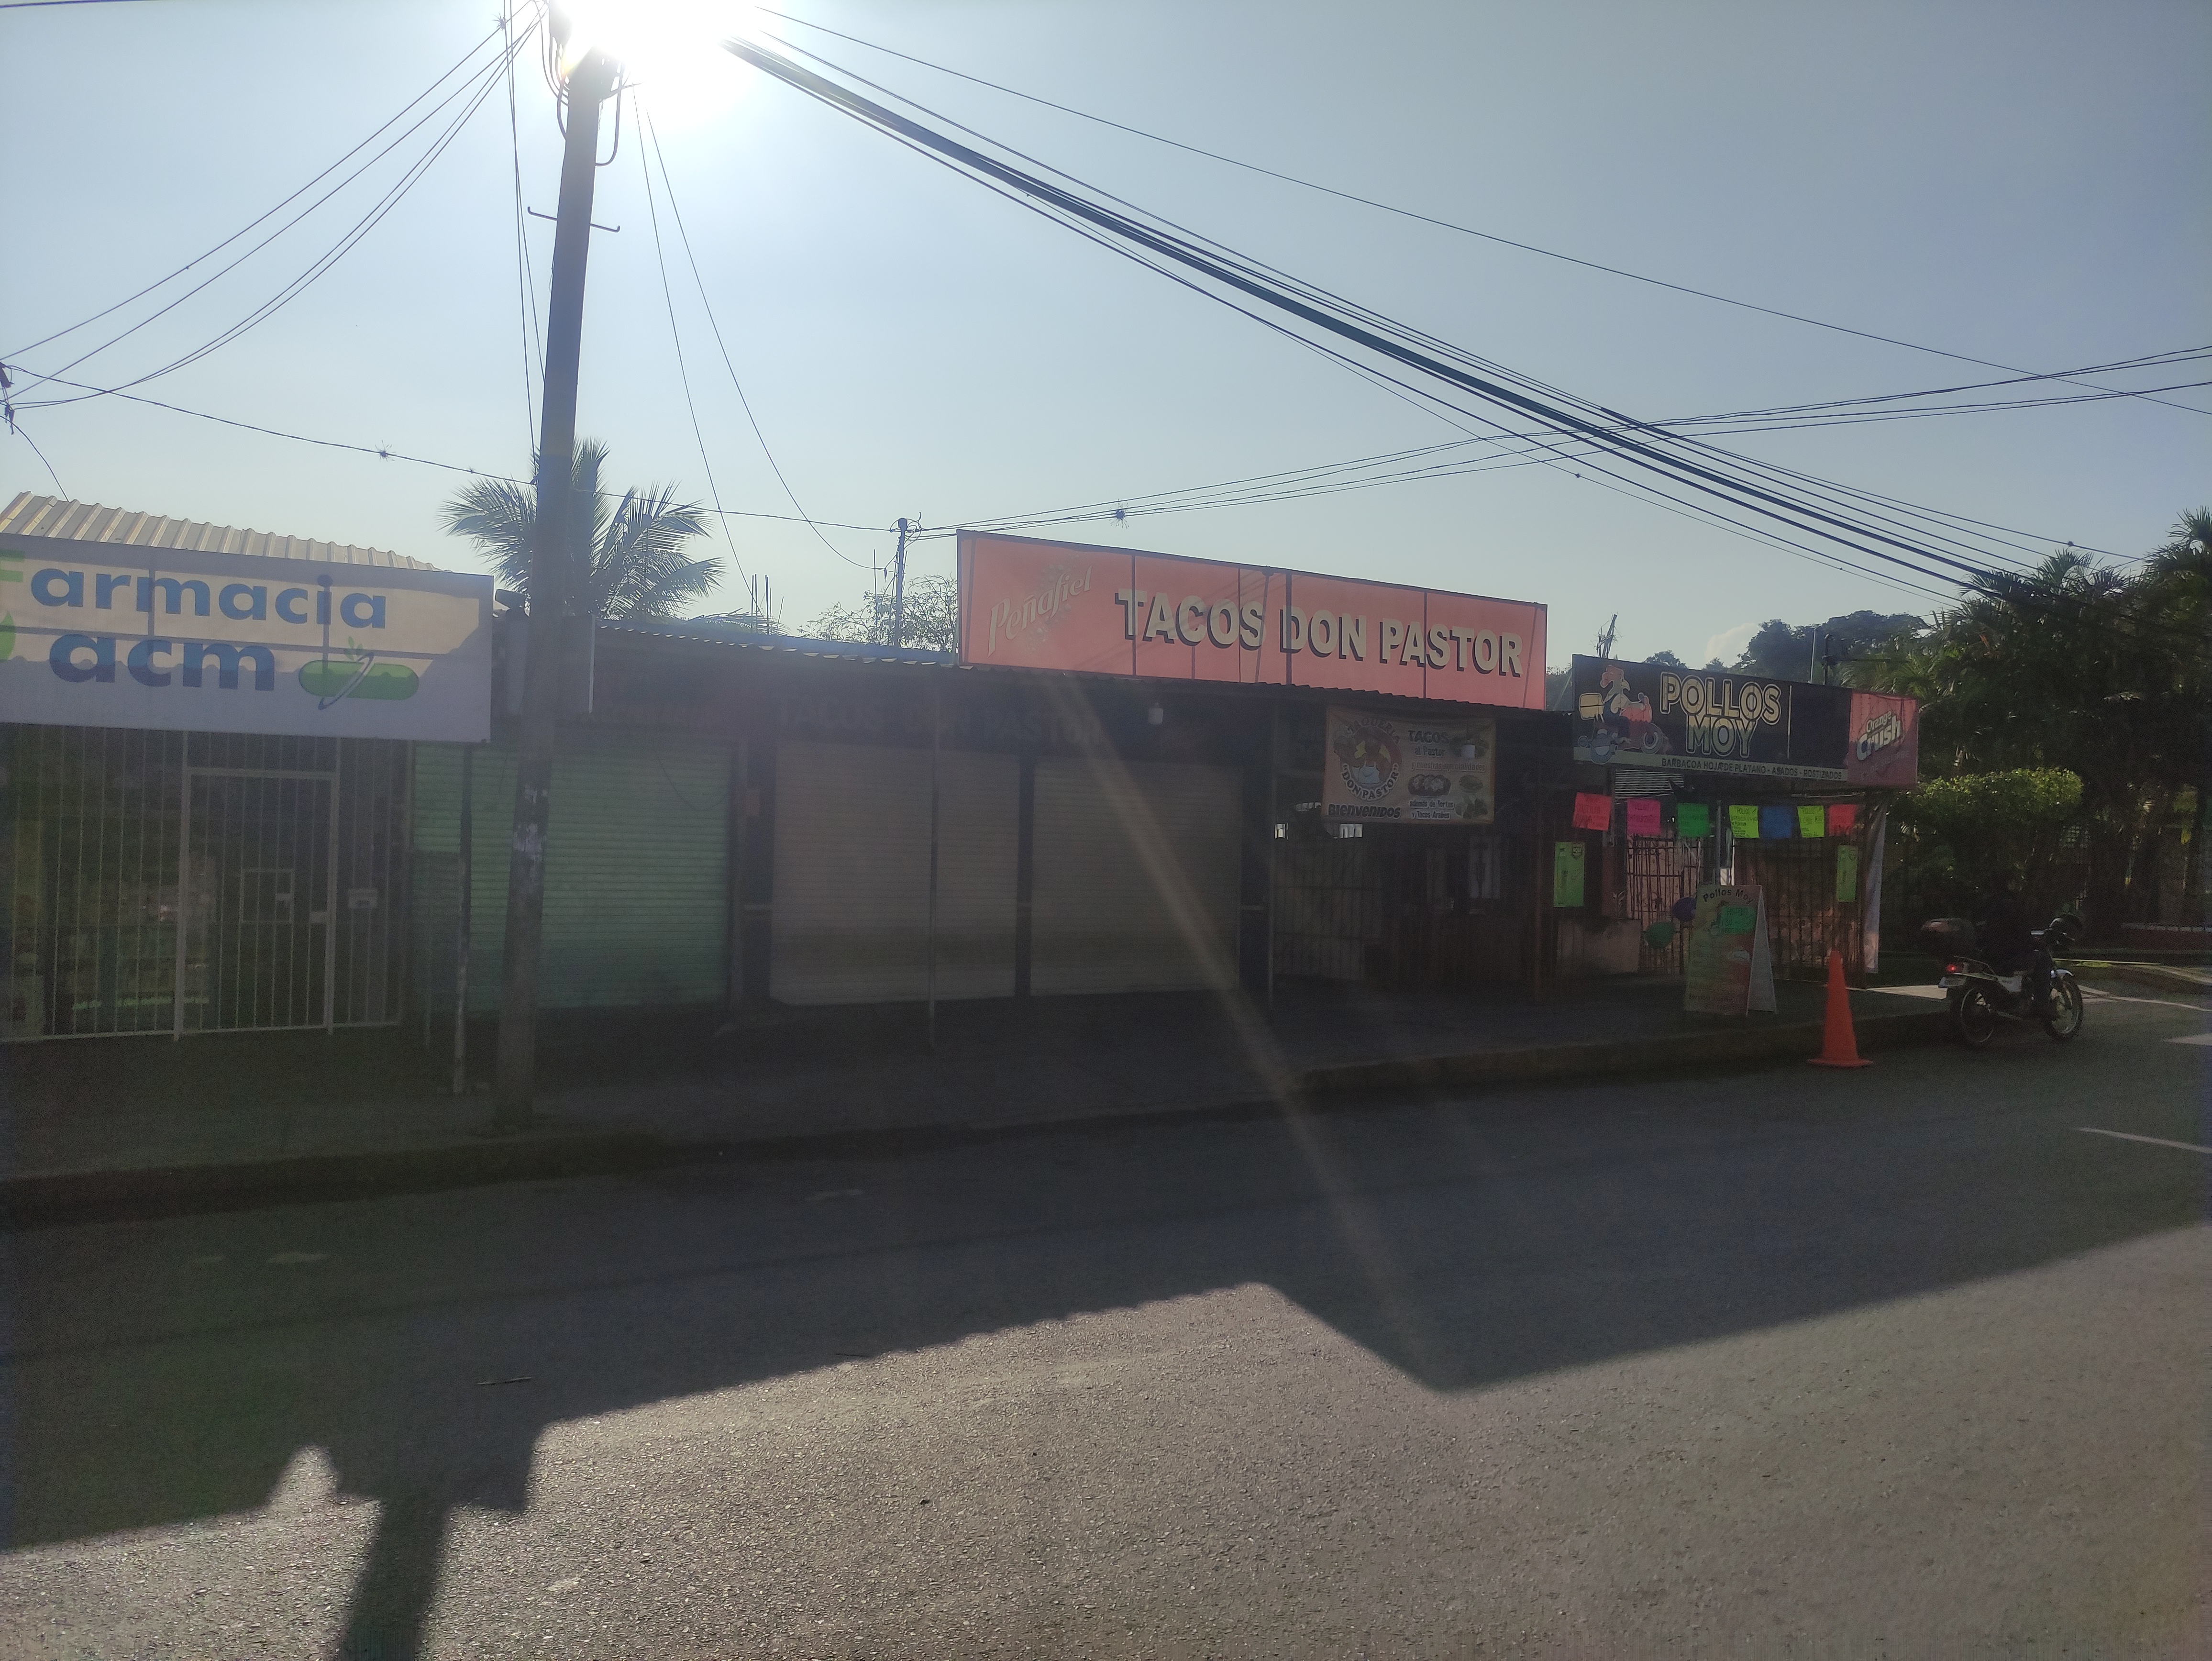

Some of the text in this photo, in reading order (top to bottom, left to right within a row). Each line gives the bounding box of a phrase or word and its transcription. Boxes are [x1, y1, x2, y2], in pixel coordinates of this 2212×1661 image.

[987, 564, 1093, 658] Peñafiel
[1115, 588, 1524, 677] TACOS DON PASTOR
[50, 634, 275, 691] acm
[1660, 672, 1781, 725] POLLOS
[1866, 711, 1891, 732] Orange
[1408, 730, 1449, 744] TACOS
[1686, 715, 1758, 758] MOY
[1857, 715, 1901, 760] Crush
[1415, 746, 1446, 756] al Pastor
[1416, 762, 1441, 770] nuestras
[1442, 762, 1486, 772] especialidades
[1662, 758, 1702, 769] BARBACOA
[1723, 763, 1734, 772] DE
[1735, 764, 1766, 774] PLATANO
[1772, 766, 1798, 776] ASADOS
[1803, 769, 1842, 779] ROSTIZADOS
[1437, 800, 1453, 808] Tortas
[1703, 888, 1755, 905] Pollos Moy
